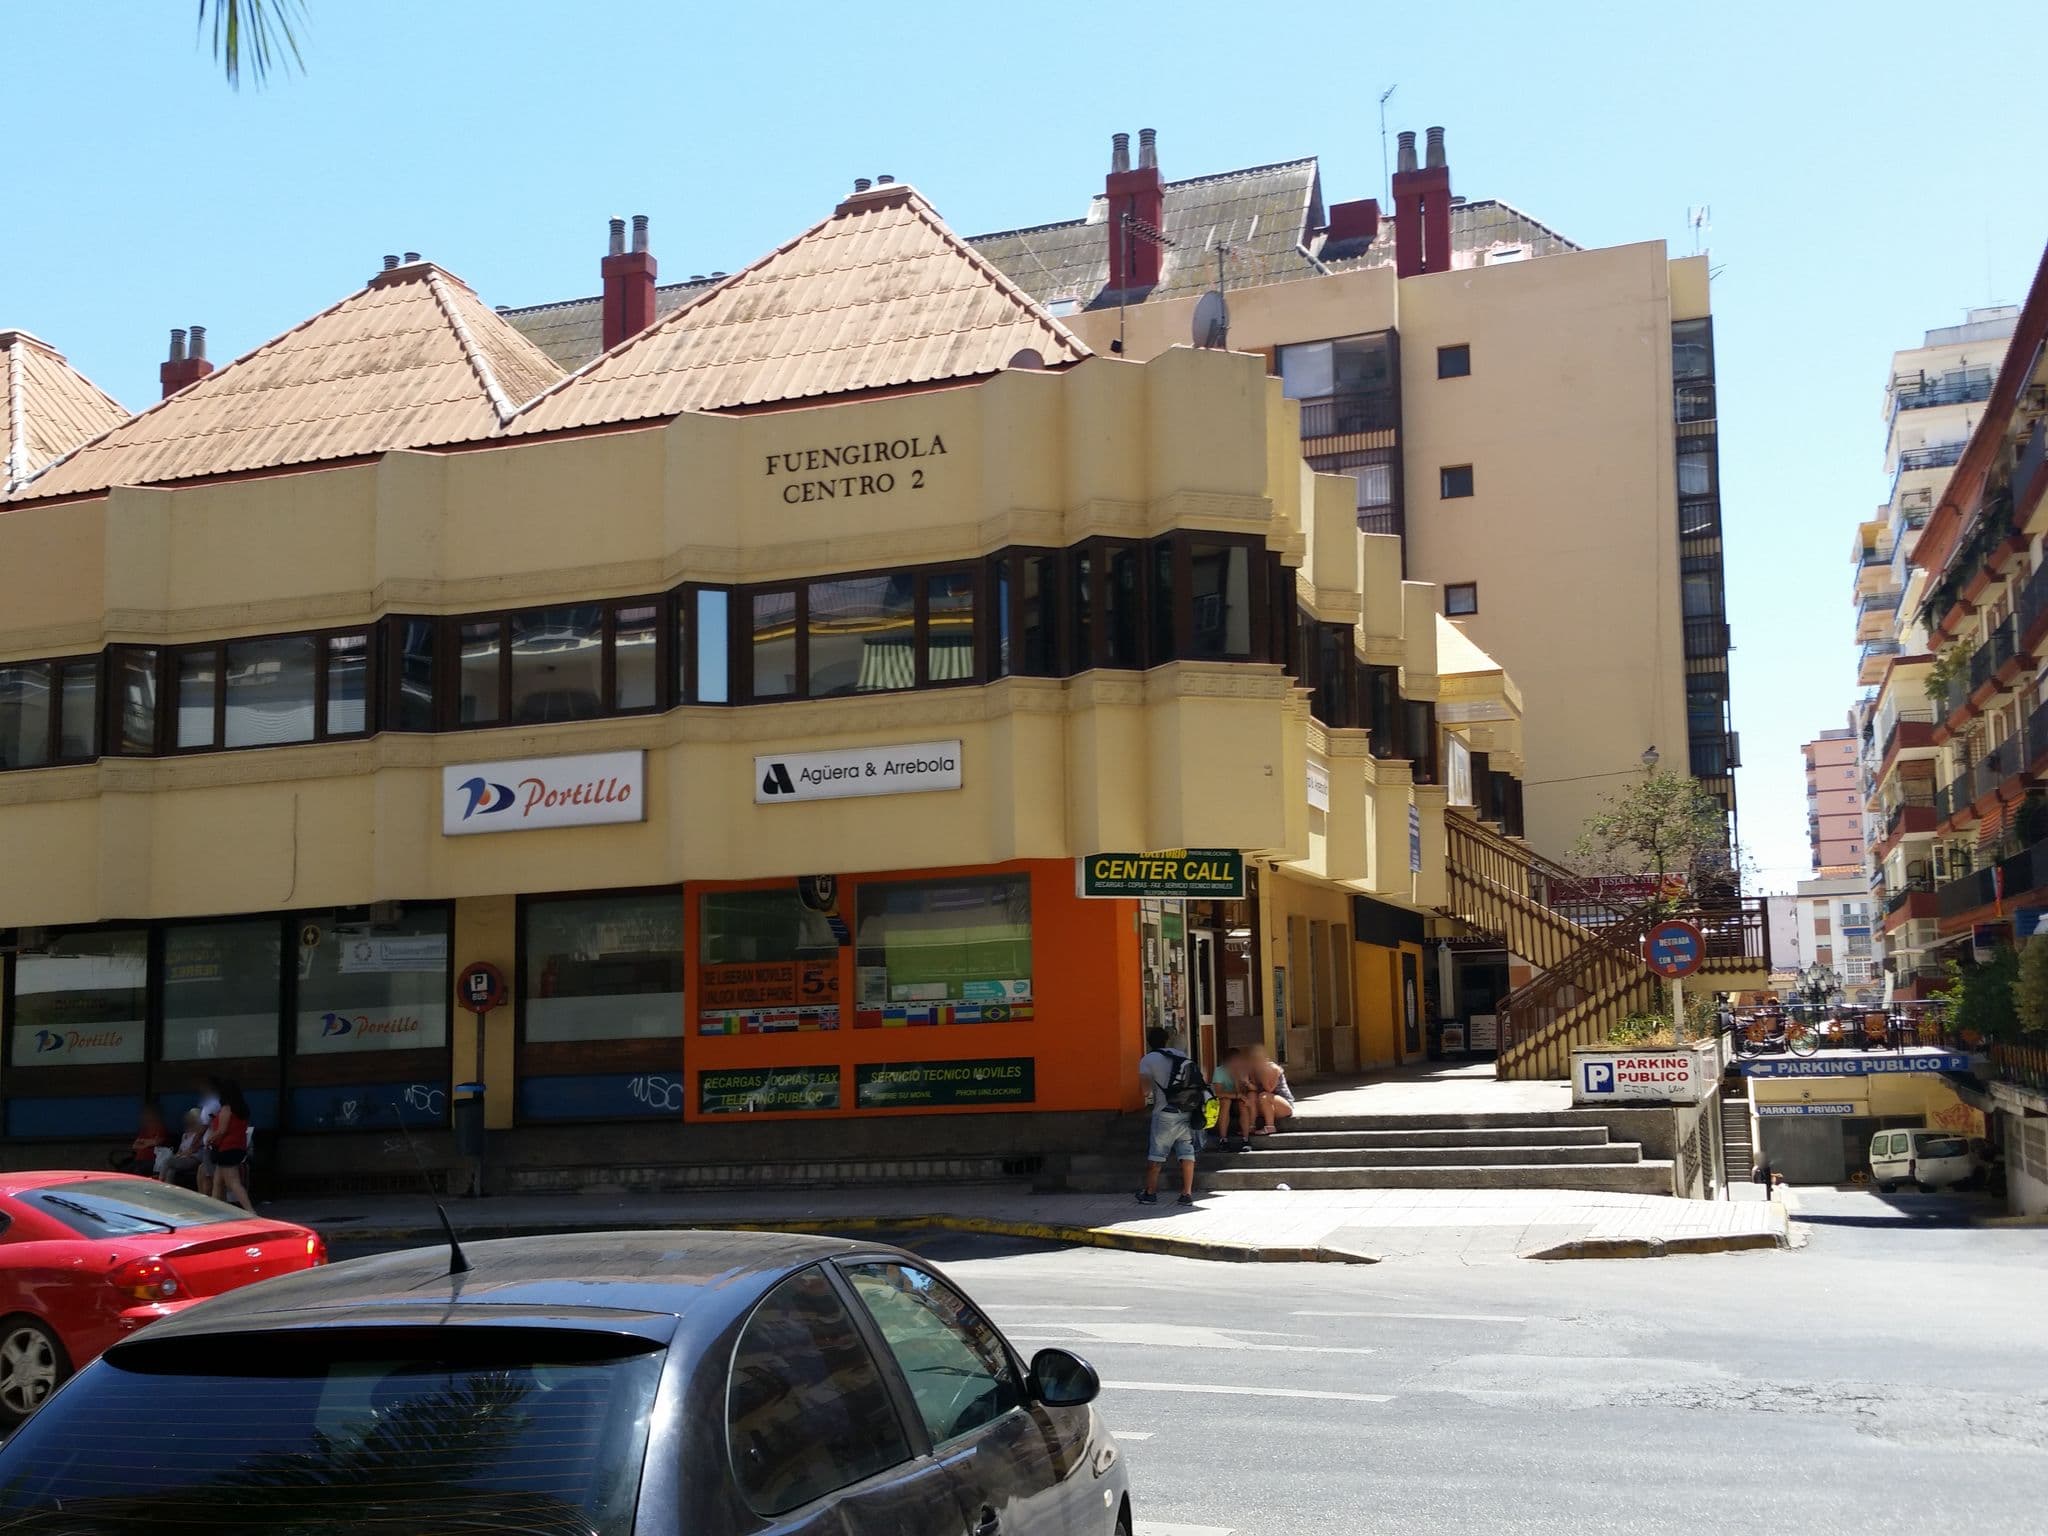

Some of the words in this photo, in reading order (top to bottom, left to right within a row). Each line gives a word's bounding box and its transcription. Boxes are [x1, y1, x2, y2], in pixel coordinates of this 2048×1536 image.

[765, 433, 948, 476] FUENGIROLA
[782, 473, 895, 504] CENTRO
[911, 469, 926, 490] 2
[800, 760, 860, 786] Agüera
[864, 761, 878, 778] &
[883, 755, 956, 776] Arrebola
[518, 777, 632, 817] Portillo
[1094, 859, 1179, 880] CENTER
[1183, 861, 1235, 881] CALL
[1600, 876, 1656, 887] RESTAURNTE
[474, 975, 484, 989] P
[353, 1015, 419, 1039] Portillo
[67, 1031, 123, 1052] Portillo
[1617, 1058, 1689, 1069] PARKING
[1777, 1061, 1856, 1074] PARKING
[1862, 1058, 1942, 1072] PUBLICO
[704, 1076, 761, 1089] RECARGAS
[770, 1074, 809, 1086] COPIAS
[818, 1073, 839, 1084] FAX
[871, 1070, 921, 1083] SERVICIO
[923, 1068, 970, 1081] TECNICO
[973, 1066, 1022, 1080] MOVILES
[1588, 1065, 1610, 1091] P
[1617, 1072, 1689, 1082] PUBLICO
[721, 1093, 776, 1105] TELEFONO
[778, 1091, 824, 1104] PUBLICO
[1759, 1106, 1803, 1115] PARKING
[1808, 1105, 1851, 1114] PRIVADO
